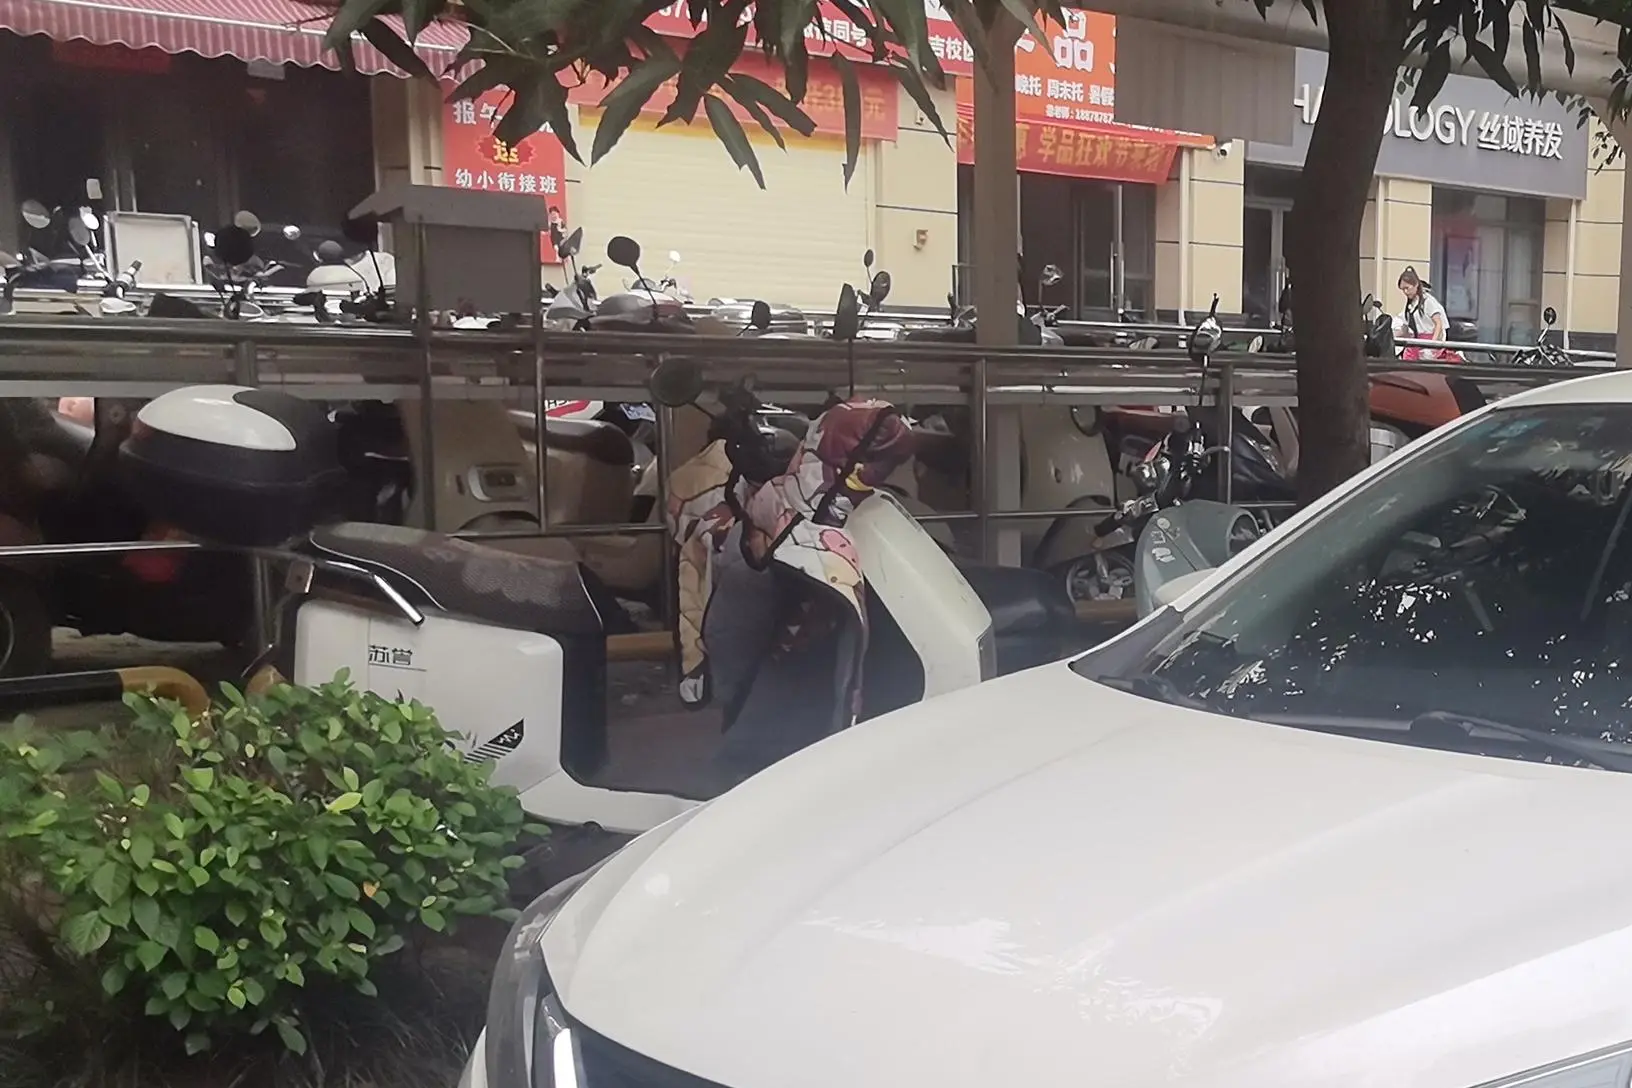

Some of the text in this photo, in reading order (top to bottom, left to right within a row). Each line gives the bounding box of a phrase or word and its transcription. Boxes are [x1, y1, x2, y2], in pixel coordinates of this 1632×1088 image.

[1047, 78, 1084, 102] 周末托
[1477, 111, 1564, 160] 丝域养发
[455, 168, 558, 194] 幼小衔接班
